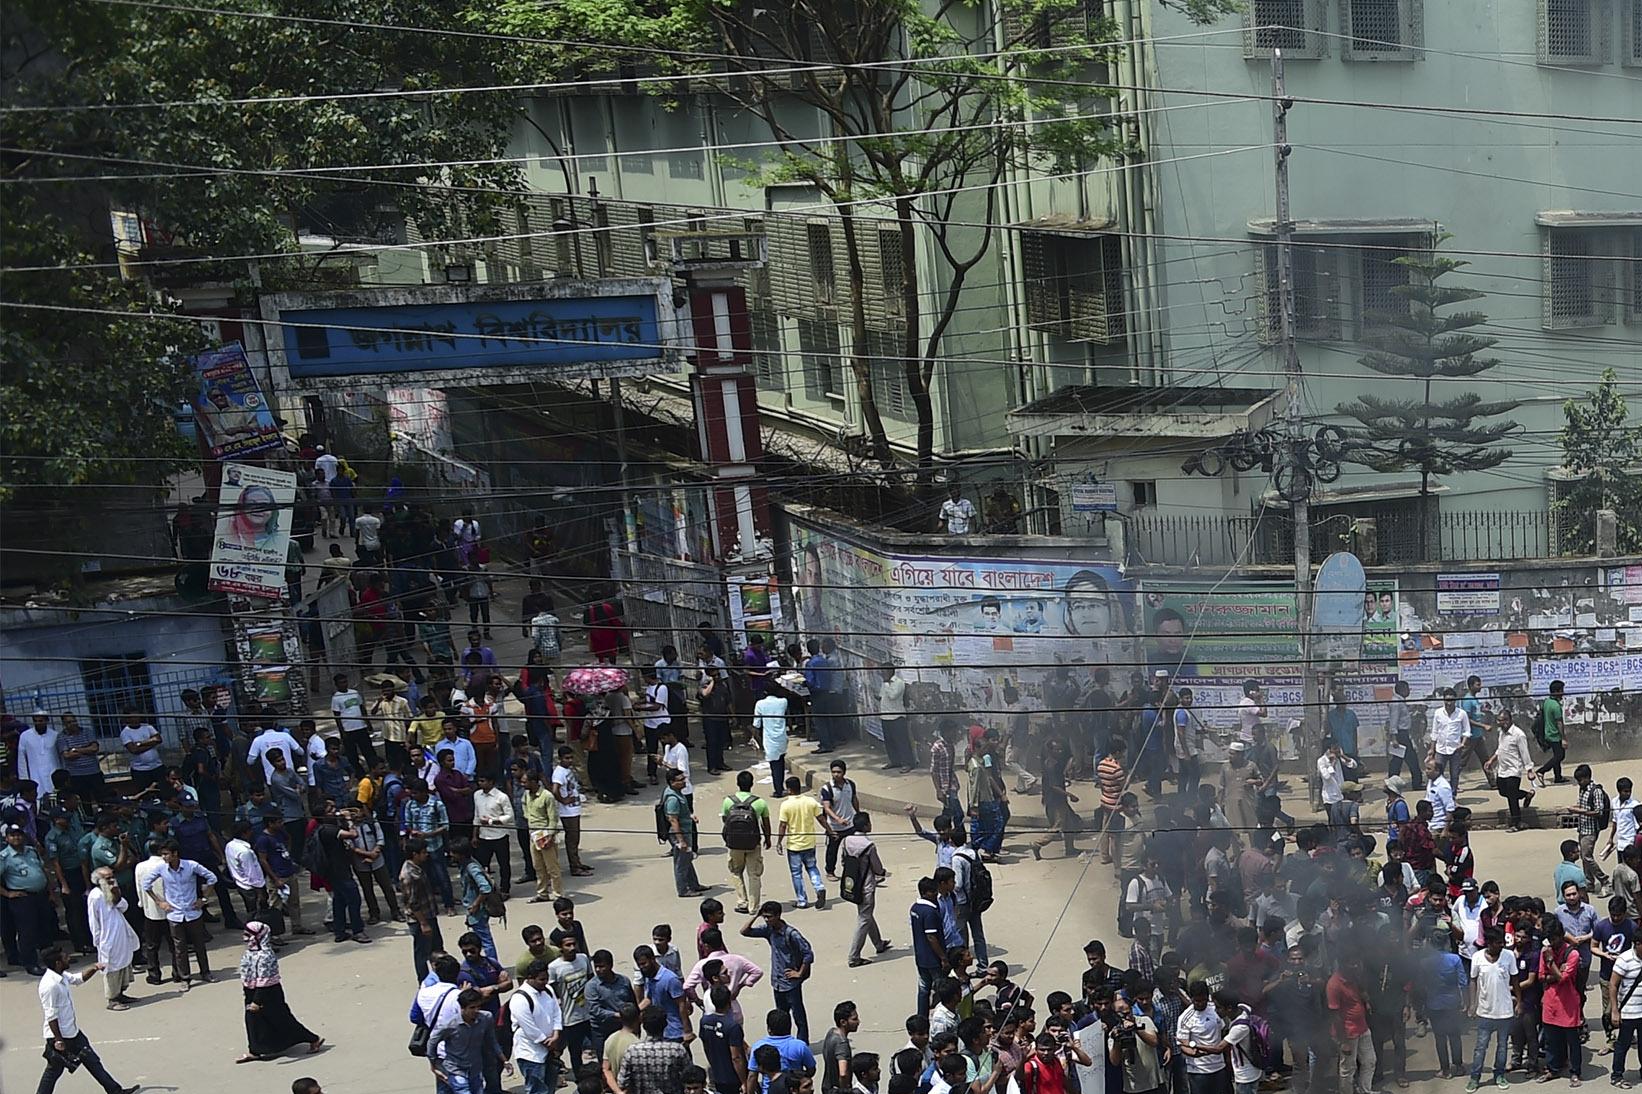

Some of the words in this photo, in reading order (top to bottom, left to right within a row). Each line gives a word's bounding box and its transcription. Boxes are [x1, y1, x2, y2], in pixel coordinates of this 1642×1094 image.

[890, 562, 934, 586] এগিয়ে
[940, 569, 975, 587] যাবে
[981, 570, 1055, 589] বাংলাদেশ
[1182, 602, 1290, 616] মনিরুজ্জামান
[1538, 663, 1556, 675] BCS
[1568, 662, 1585, 673] BCS
[1597, 661, 1615, 673] BCS
[1283, 691, 1300, 702] BCS
[1205, 973, 1224, 987] NICE
